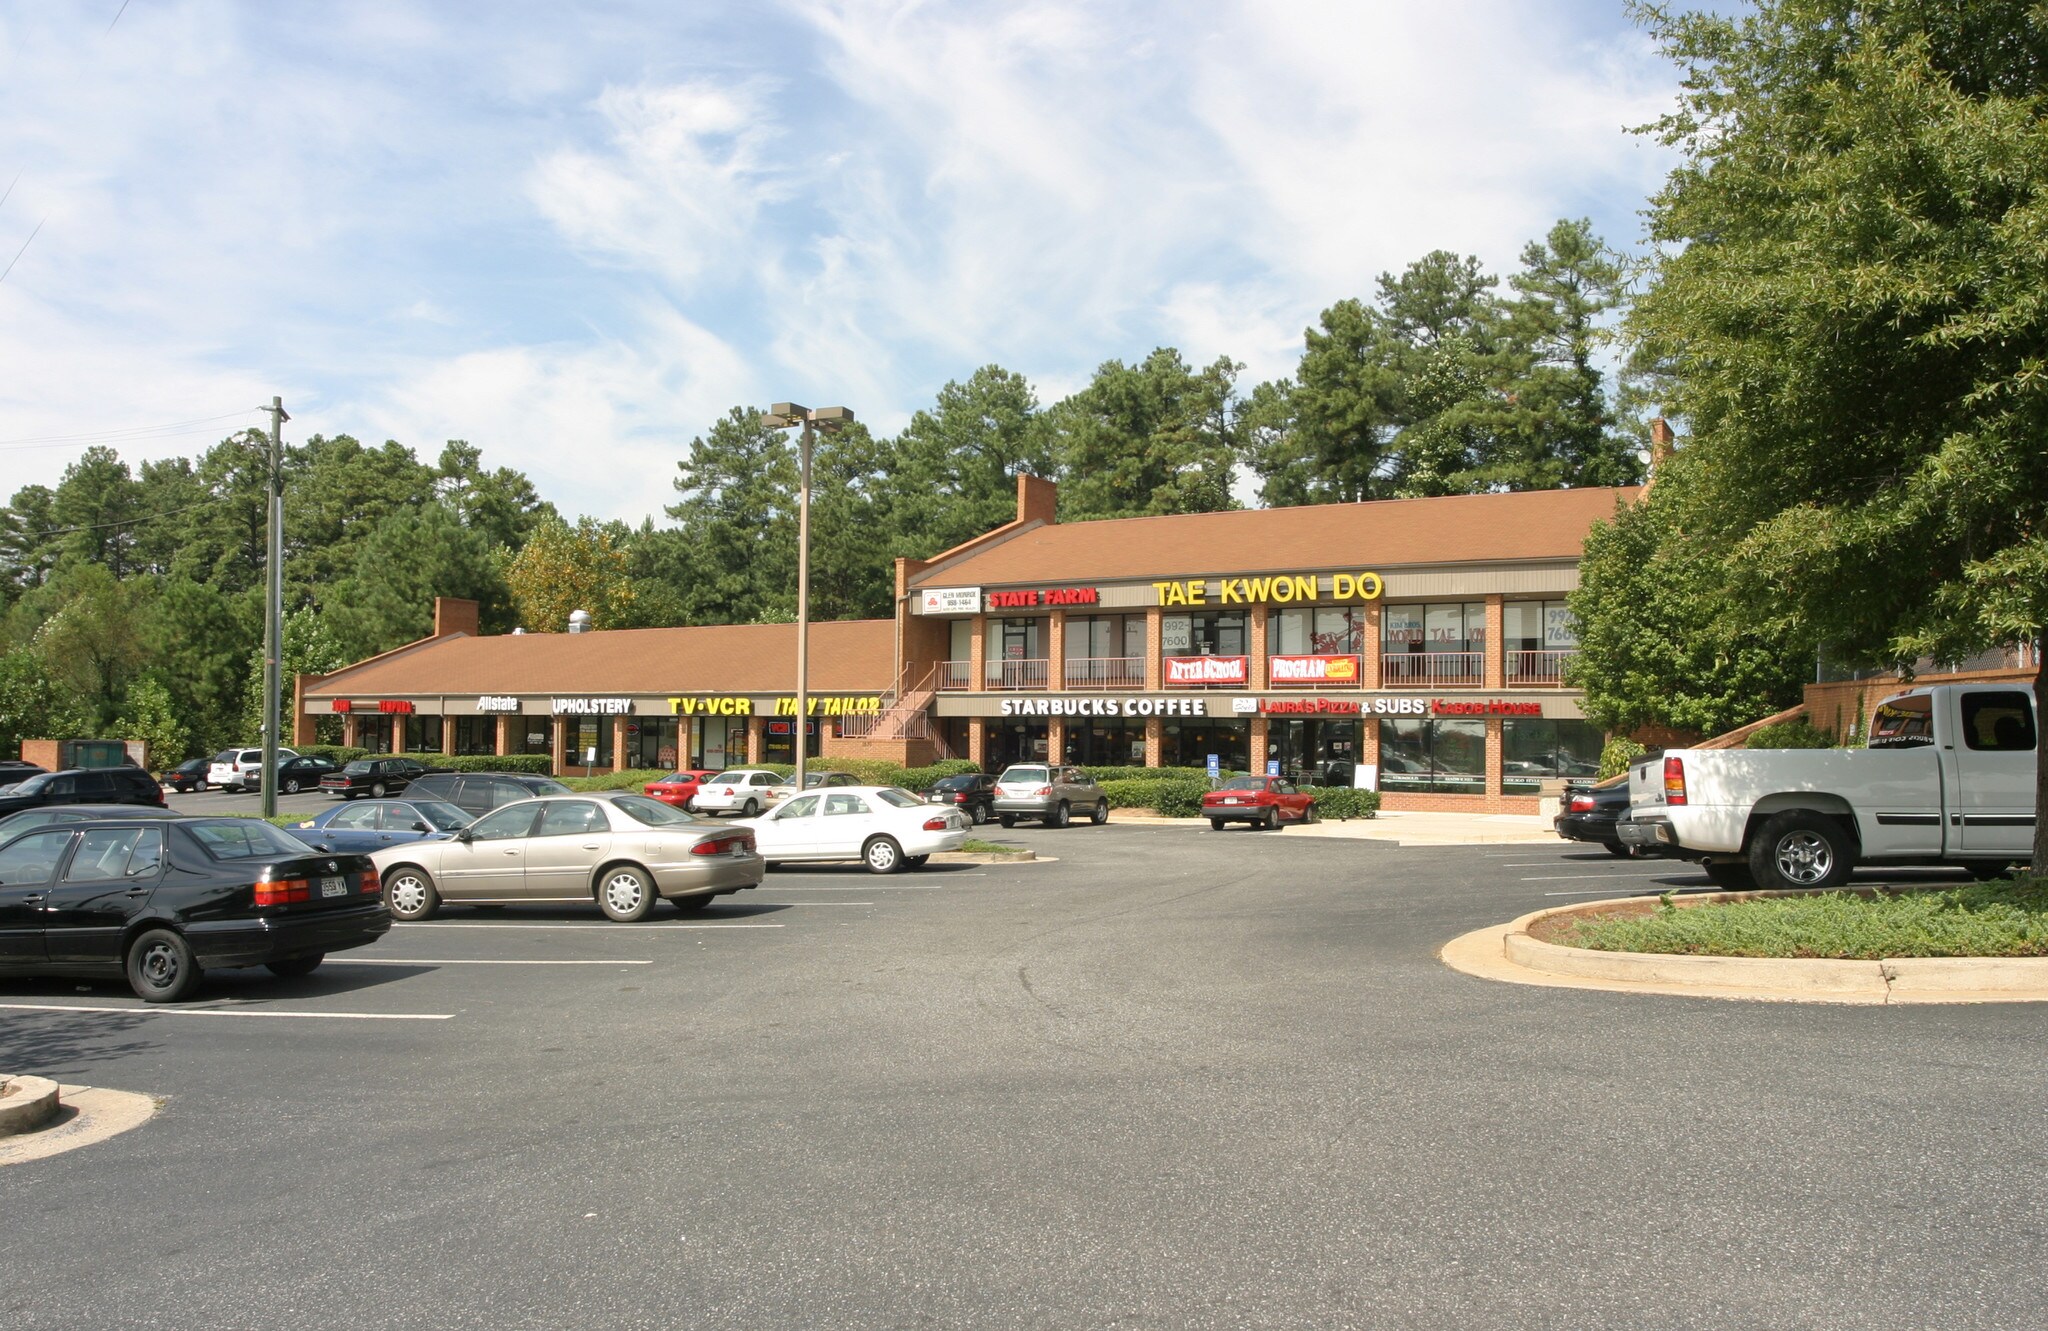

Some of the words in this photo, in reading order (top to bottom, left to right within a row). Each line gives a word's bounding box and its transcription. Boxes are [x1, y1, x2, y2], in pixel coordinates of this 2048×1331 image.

[990, 590, 1038, 607] STATE
[1044, 587, 1097, 605] FARM
[1152, 580, 1206, 606] TAE
[1221, 575, 1318, 604] KWON
[1333, 572, 1382, 600] DO
[1162, 636, 1188, 646] 7600
[1388, 629, 1424, 644] WORLD
[1430, 628, 1456, 643] TAE
[1169, 659, 1203, 680] AFTER
[1204, 658, 1243, 679] SCHOOL
[1272, 657, 1326, 678] PROGRAM
[476, 696, 518, 711] Allstate
[552, 698, 631, 714] UPHOLSTERY
[774, 697, 818, 715] ITAY
[823, 697, 880, 716] TAILOR
[1001, 698, 1119, 716] STARBUCKS
[1124, 698, 1205, 716] COFFEE
[1316, 698, 1360, 714] PIZZA
[1374, 698, 1424, 714] SUBS
[1431, 699, 1484, 715] KABOB
[1489, 700, 1541, 716] HOUSE
